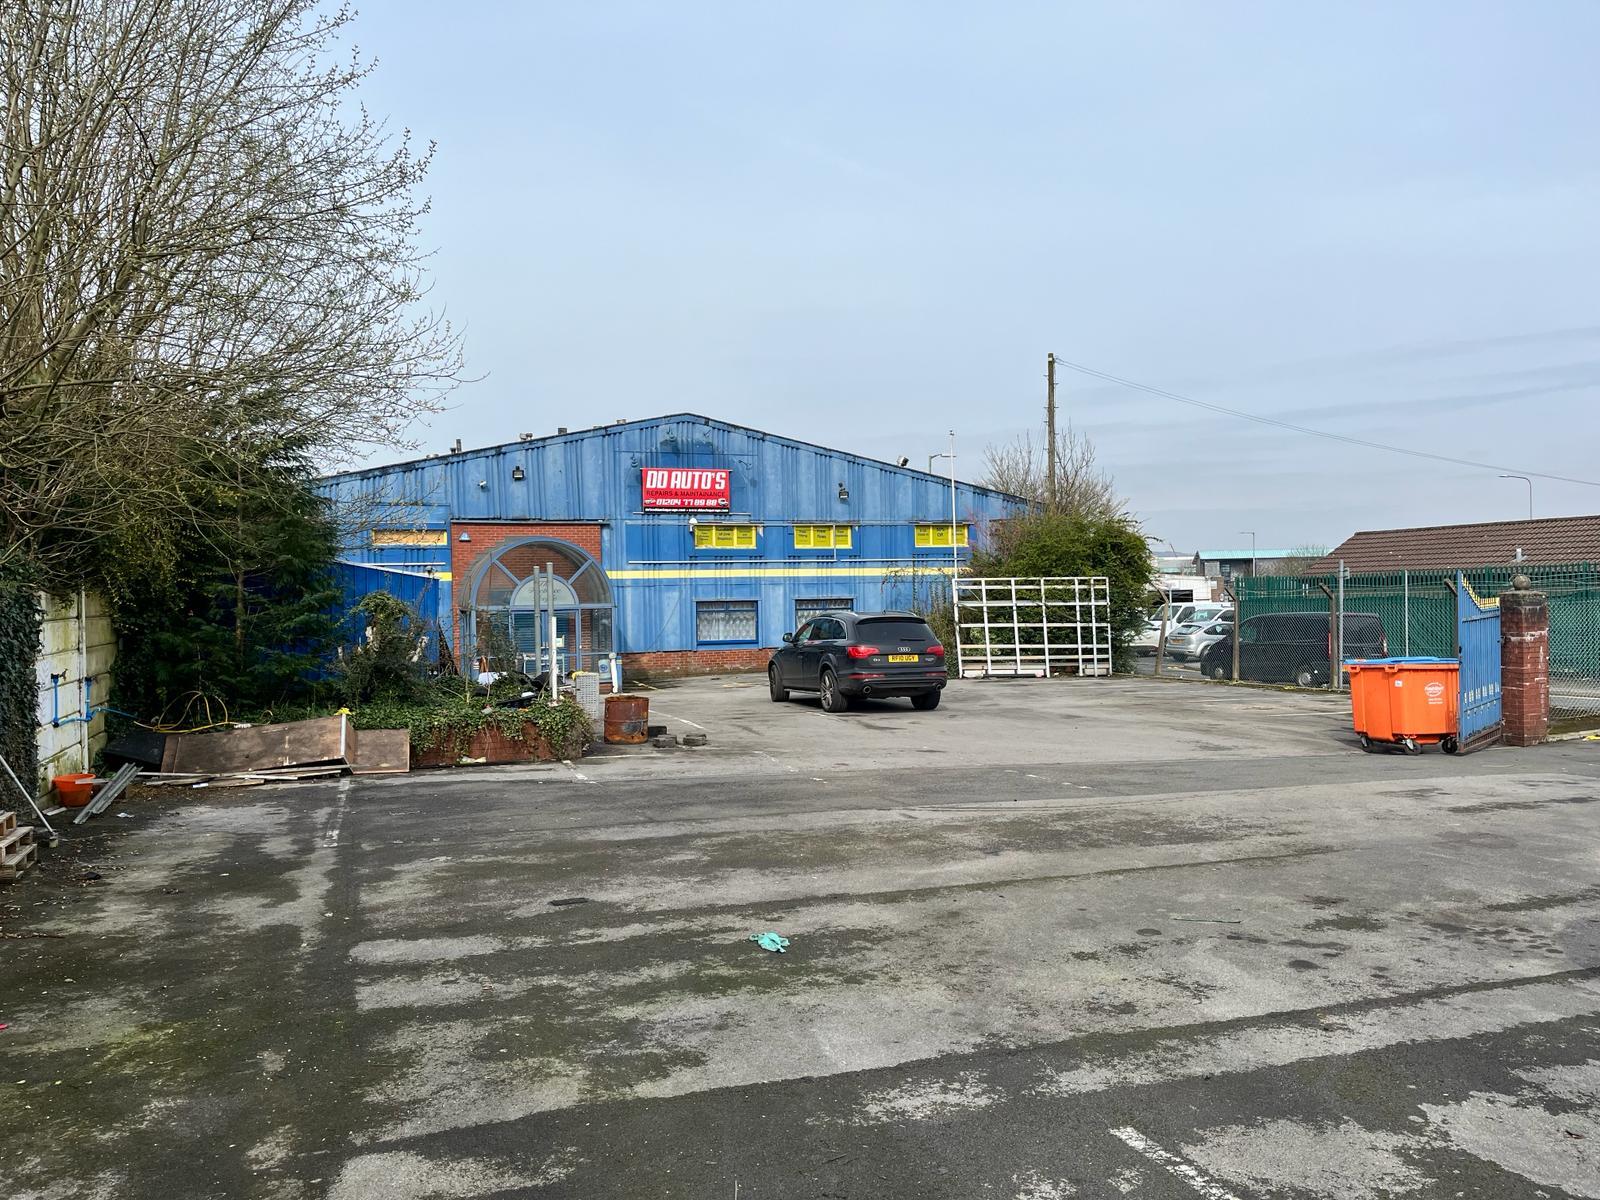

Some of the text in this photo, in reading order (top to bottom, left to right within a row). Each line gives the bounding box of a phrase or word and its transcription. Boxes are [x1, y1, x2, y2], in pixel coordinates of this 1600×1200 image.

[645, 471, 727, 490] DD AUTO'S
[656, 498, 682, 506] 01204
